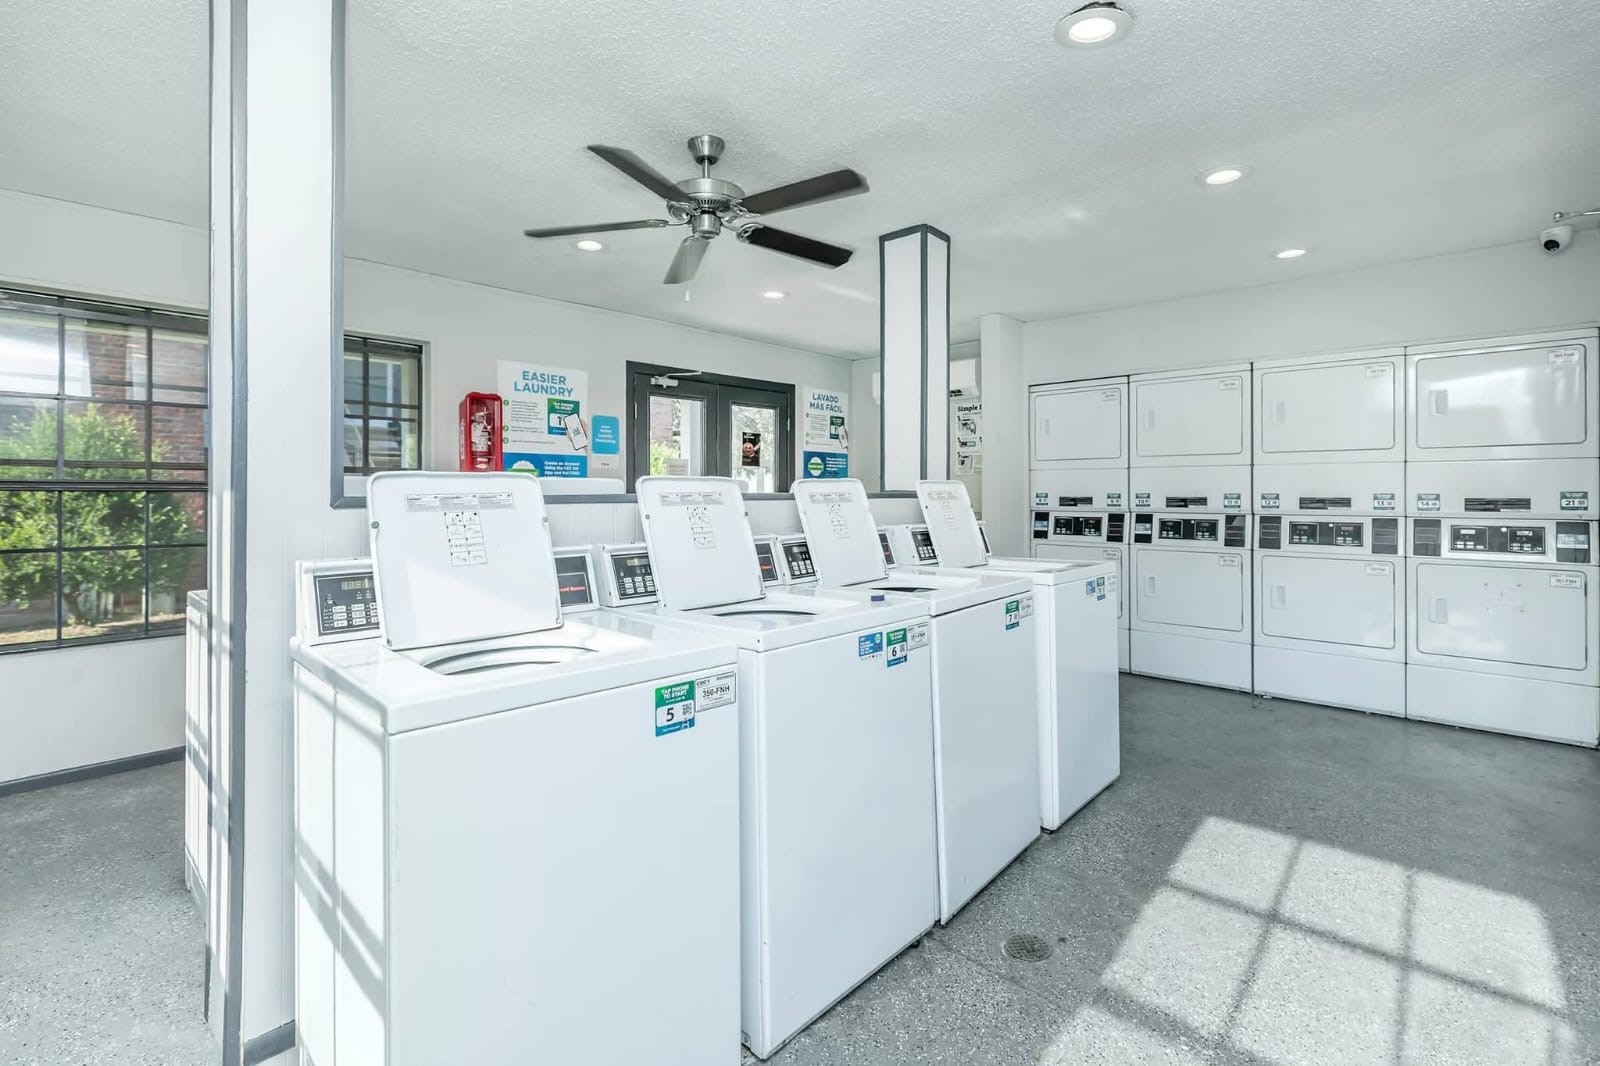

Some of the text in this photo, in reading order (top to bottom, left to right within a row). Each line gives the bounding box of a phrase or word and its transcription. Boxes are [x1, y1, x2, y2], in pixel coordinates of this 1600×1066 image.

[522, 370, 566, 385] EASIER
[514, 382, 574, 397] LAUNDRY
[812, 392, 839, 402] LAVADO
[809, 401, 843, 413] MÁS FÁCIL
[957, 404, 979, 413] Simple
[1008, 614, 1012, 623] 7
[891, 646, 897, 657] 6
[702, 684, 730, 698] 350-FNH
[666, 707, 675, 722] 5
